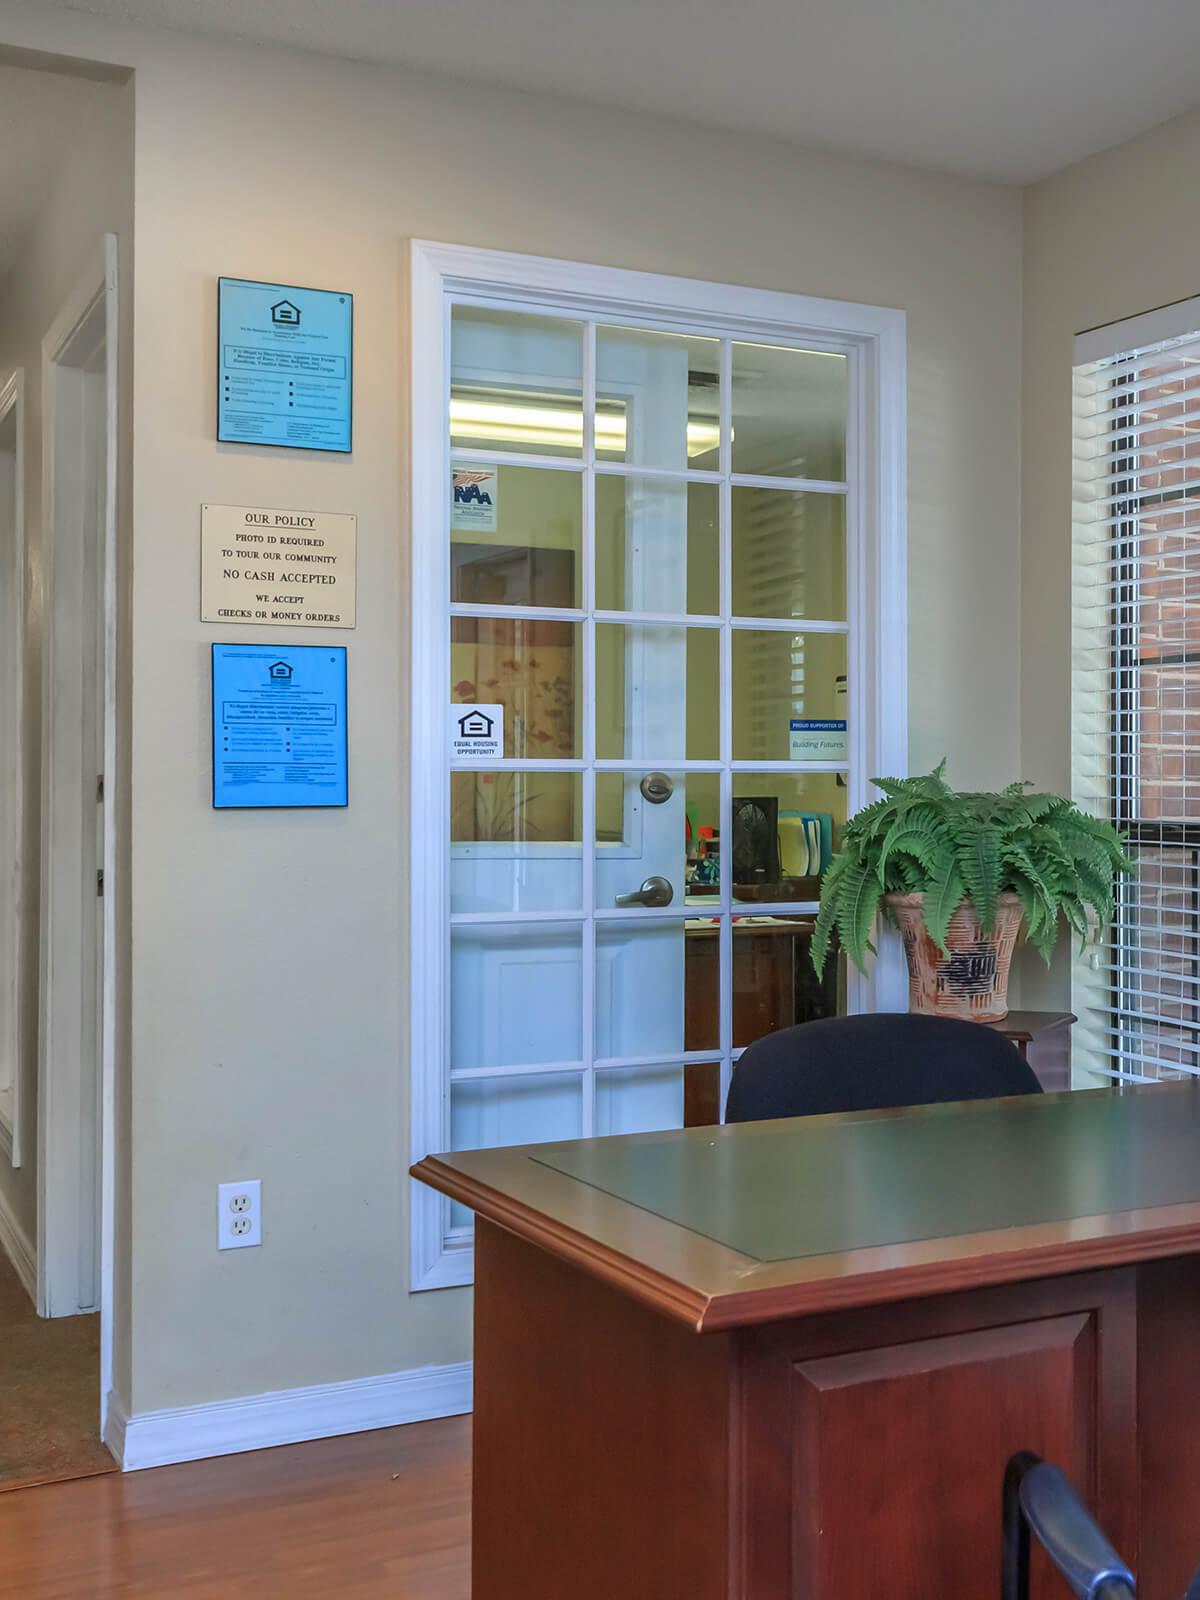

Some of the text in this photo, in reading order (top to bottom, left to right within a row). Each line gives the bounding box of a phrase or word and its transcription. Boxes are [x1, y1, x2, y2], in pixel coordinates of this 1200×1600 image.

[245, 513, 315, 527] OUR POLICY
[236, 534, 324, 547] PHOTO ID REQUIRED
[222, 549, 337, 564] TO TOUR OUR COMMUNITY
[223, 569, 336, 585] NO CASH ACCEPTED
[256, 594, 304, 604] WE ACCEPT
[218, 609, 341, 622] CHECKS OR MONEY ORDERS
[792, 740, 818, 749] Building
